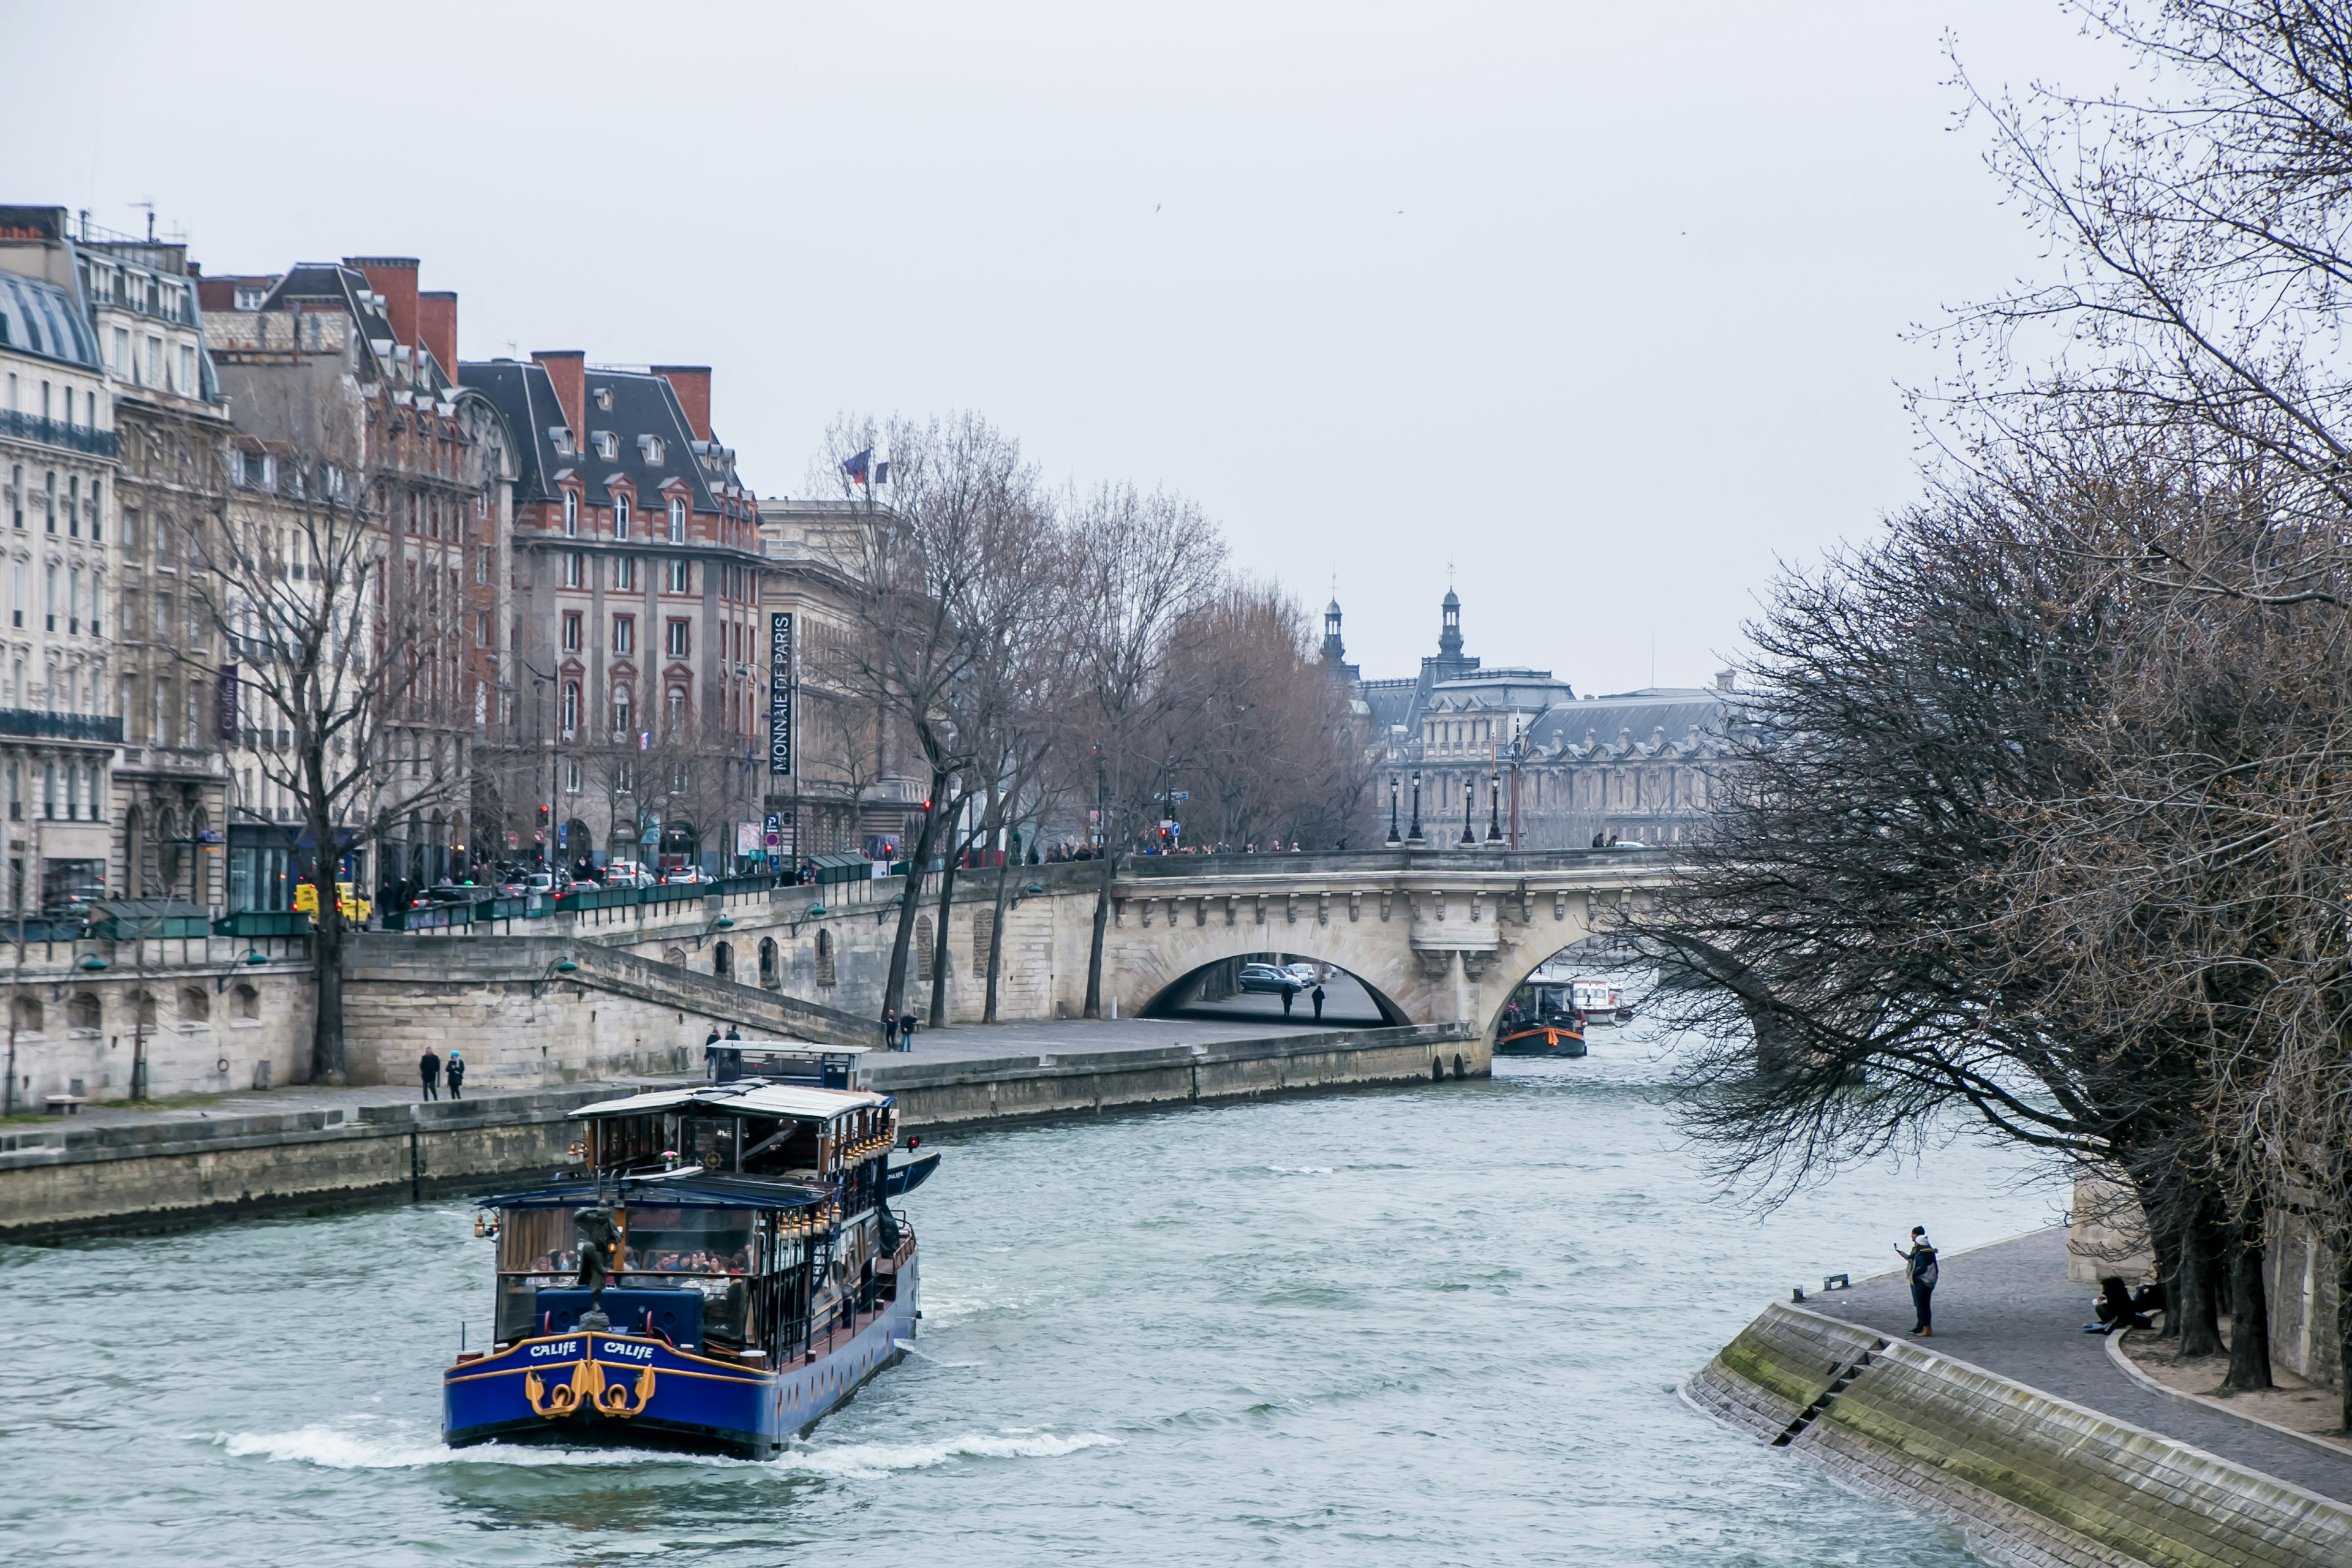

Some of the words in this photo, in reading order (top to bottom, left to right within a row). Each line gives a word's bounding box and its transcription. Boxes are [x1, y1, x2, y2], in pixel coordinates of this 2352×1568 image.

[775, 617, 789, 664] PARIS
[774, 668, 787, 689] DE
[773, 694, 787, 770] MONNAIE
[887, 1171, 904, 1180] ALIFE
